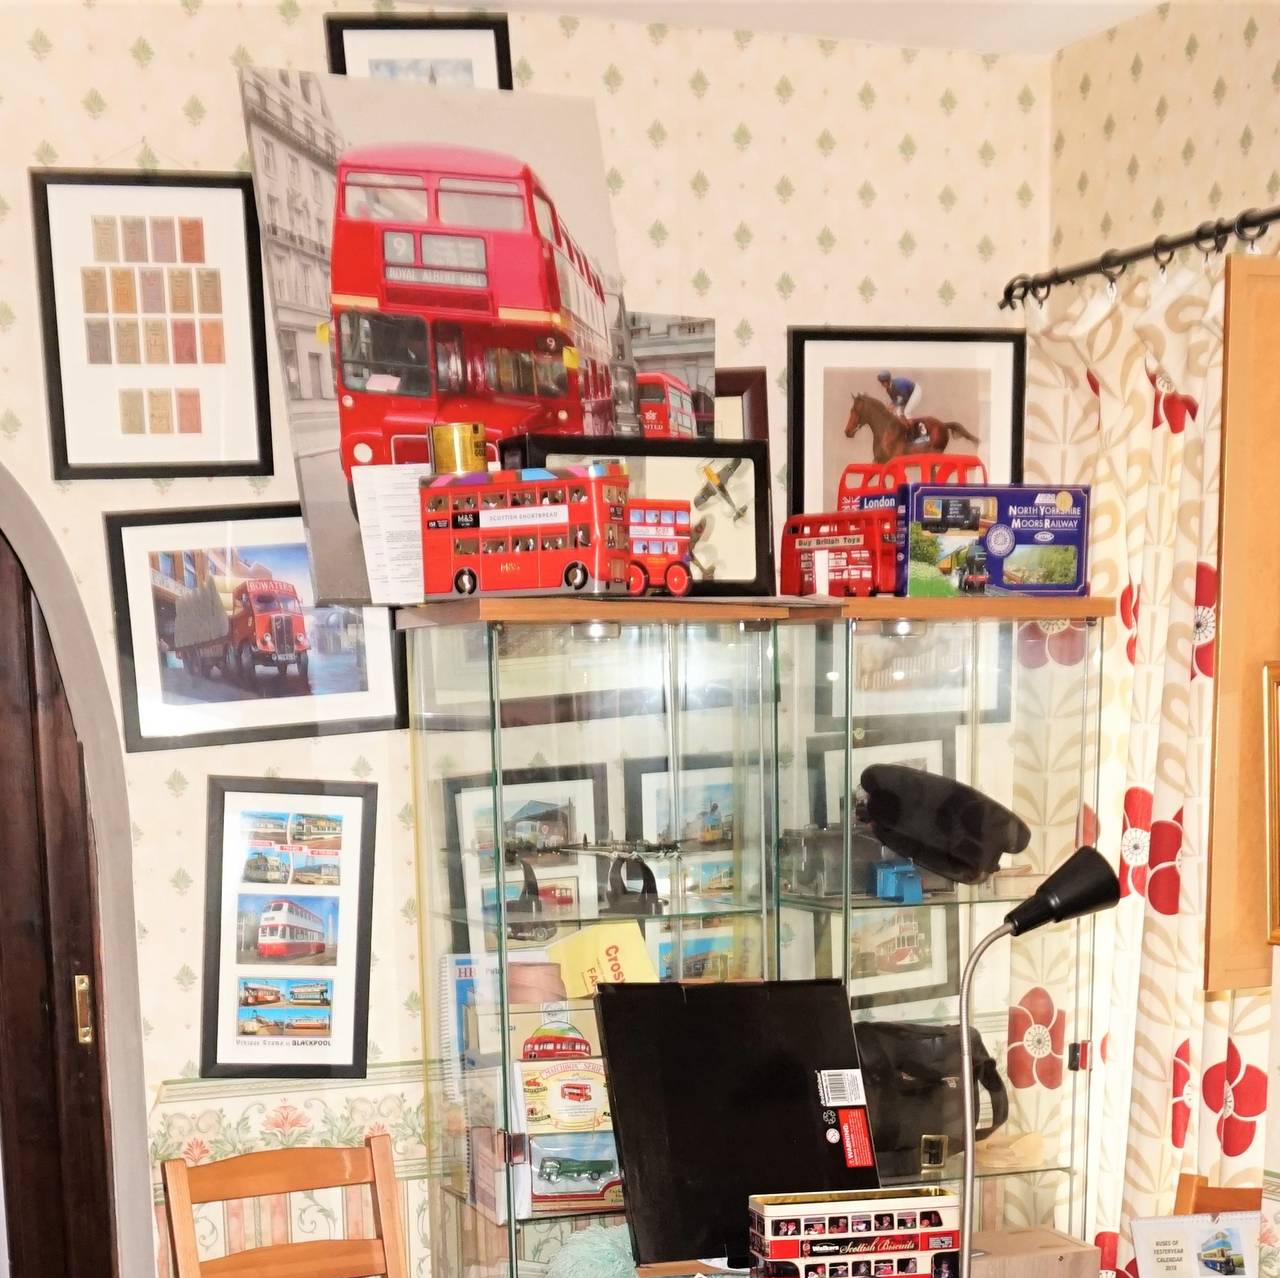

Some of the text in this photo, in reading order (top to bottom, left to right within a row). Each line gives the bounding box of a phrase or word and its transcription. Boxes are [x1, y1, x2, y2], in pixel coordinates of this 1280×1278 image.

[392, 237, 407, 257] 9
[422, 270, 456, 282] ALBERT
[546, 337, 557, 350] 9
[863, 496, 896, 509] London
[489, 513, 518, 521] SCOTTISH
[519, 511, 558, 521] SHORTBREAD
[1008, 505, 1038, 516] NORTH
[1011, 518, 1079, 529] MOORS RAILWAY
[798, 536, 862, 549] Buy British Toys
[604, 944, 626, 984] Cros
[839, 1236, 879, 1254] Scottish
[878, 1239, 915, 1252] Biscuits
